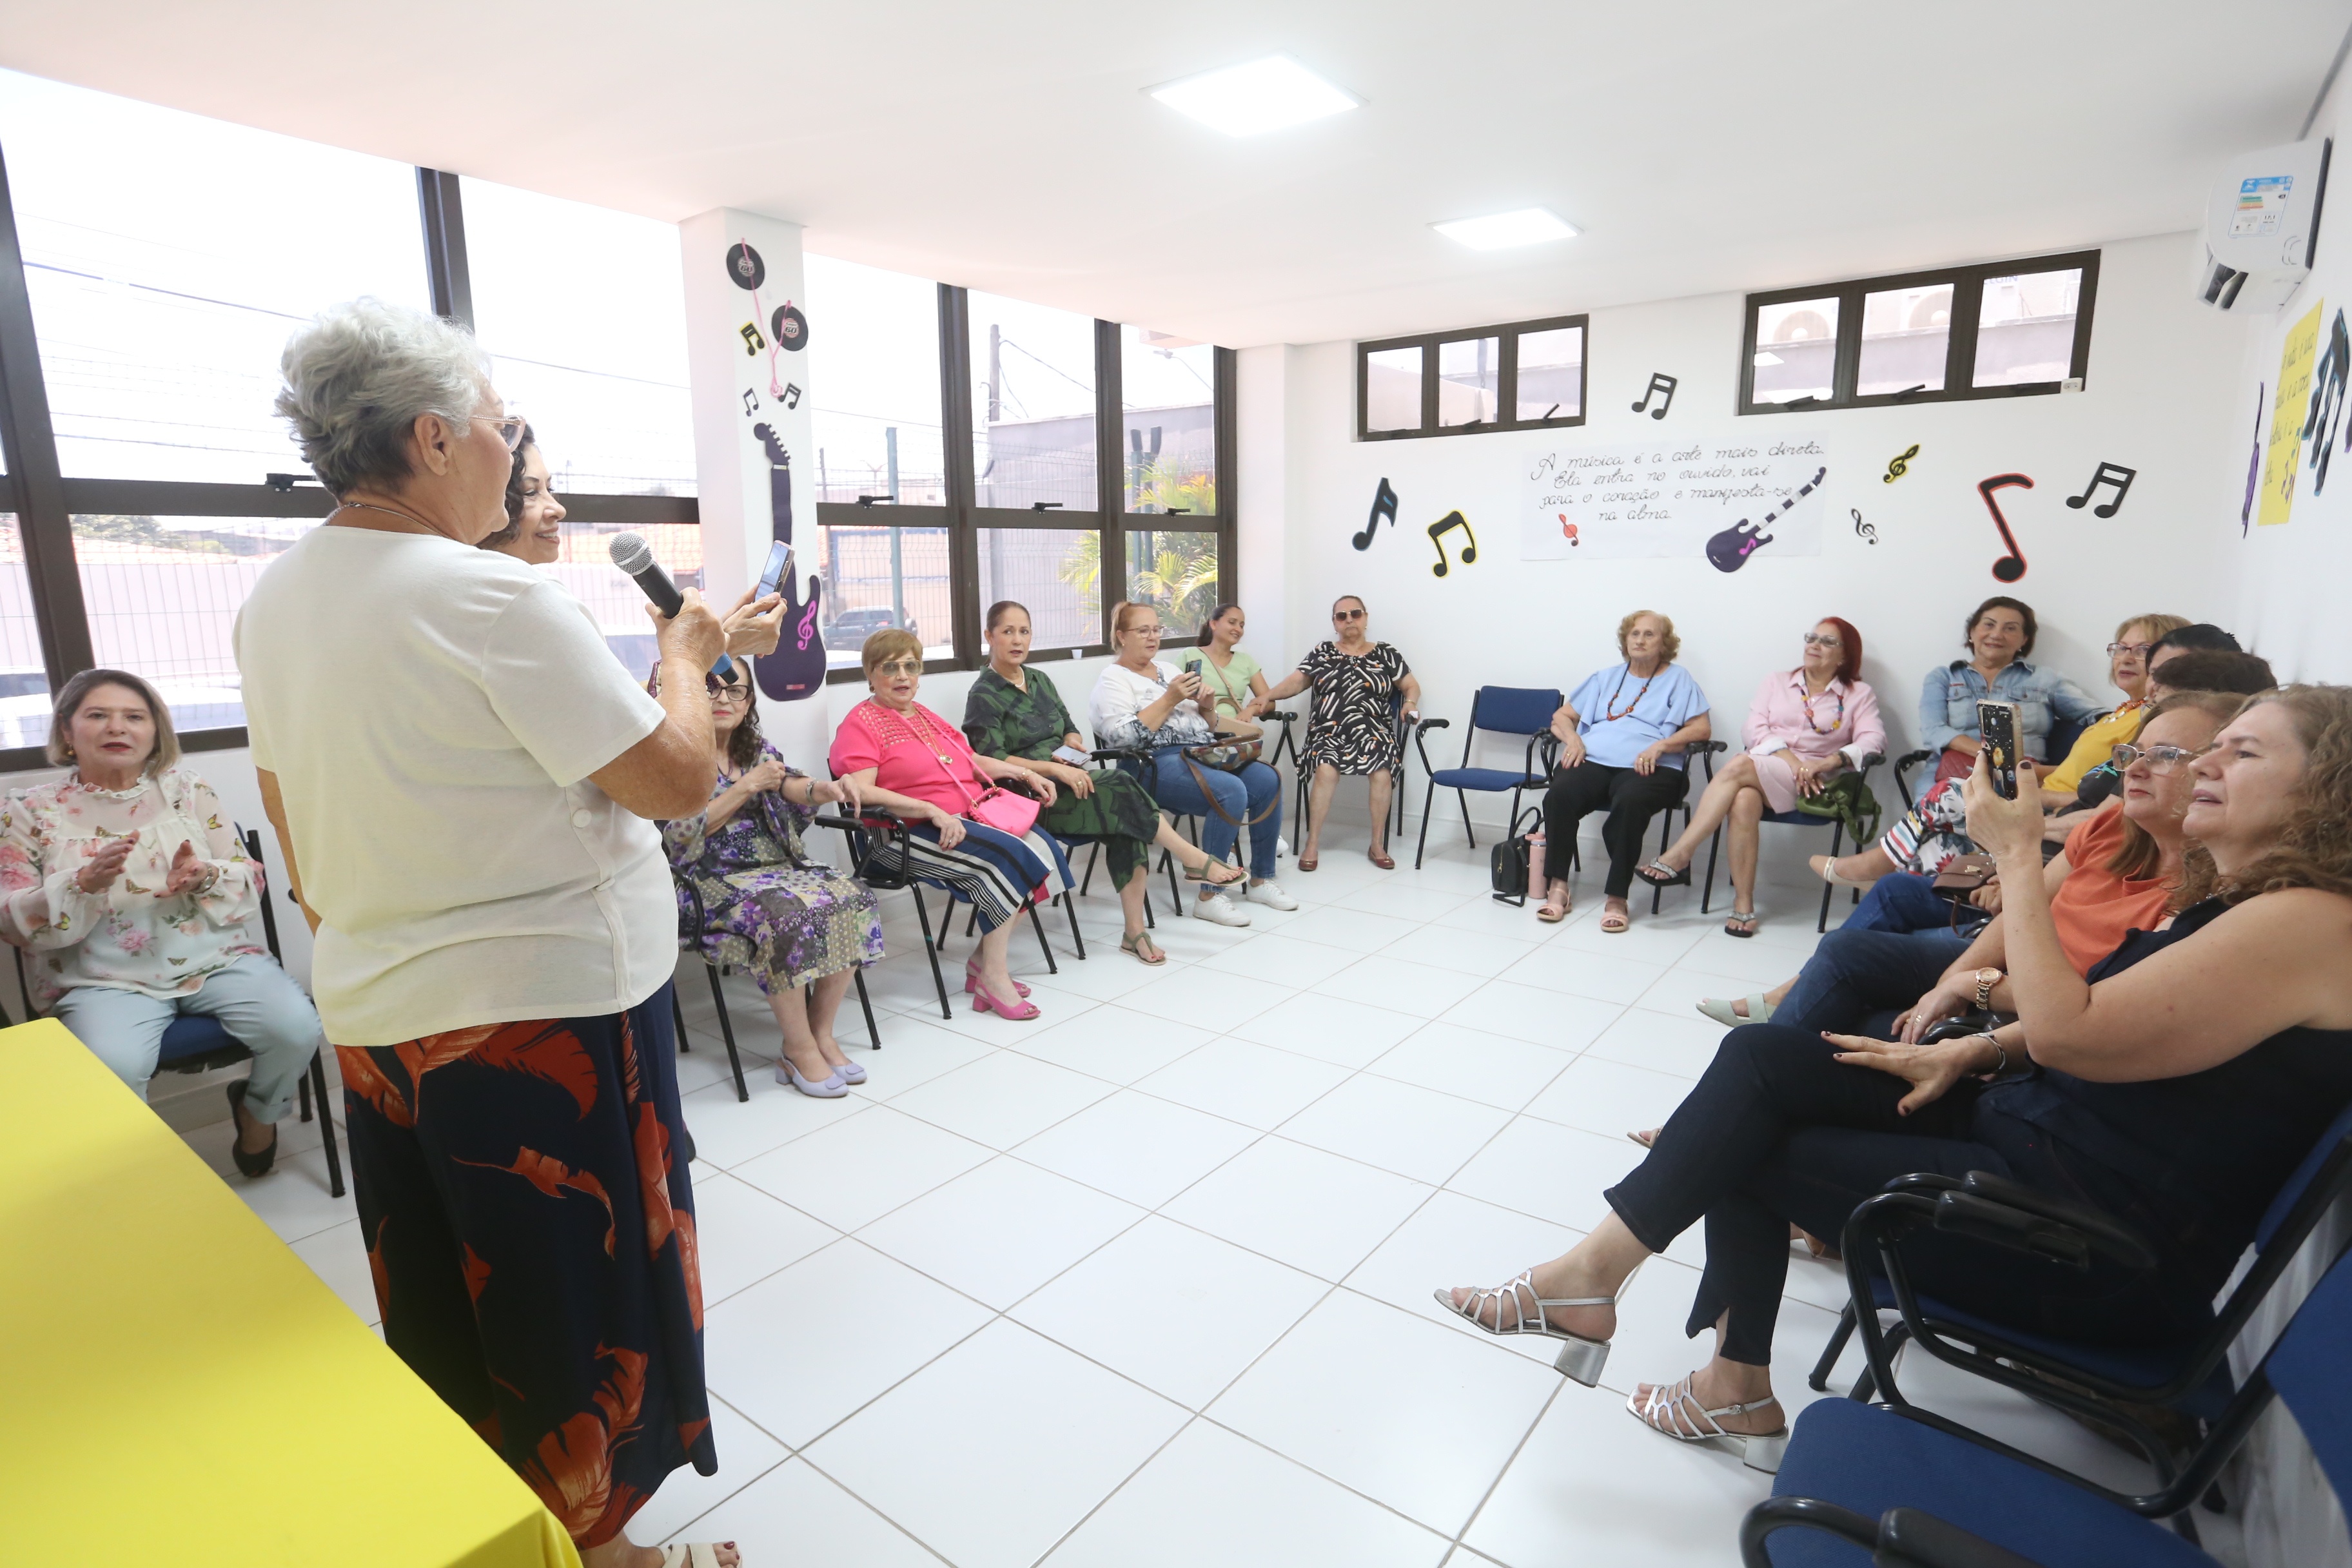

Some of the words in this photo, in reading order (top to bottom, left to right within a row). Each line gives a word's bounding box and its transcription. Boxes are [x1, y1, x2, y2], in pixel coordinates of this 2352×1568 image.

[1531, 453, 1555, 480] A
[1568, 455, 1623, 467] música
[1634, 453, 1644, 464] é
[1652, 453, 1663, 462] a
[1672, 445, 1701, 462] arte
[1715, 447, 1757, 458] mais
[1554, 471, 1580, 489] Ela
[1594, 468, 1633, 484] entra
[1647, 472, 1665, 481] no
[1741, 465, 1769, 476] vai
[1540, 495, 1573, 509] para
[1583, 494, 1592, 503] o
[1603, 489, 1659, 503] coração
[1674, 490, 1682, 500] e
[1599, 511, 1616, 521] na
